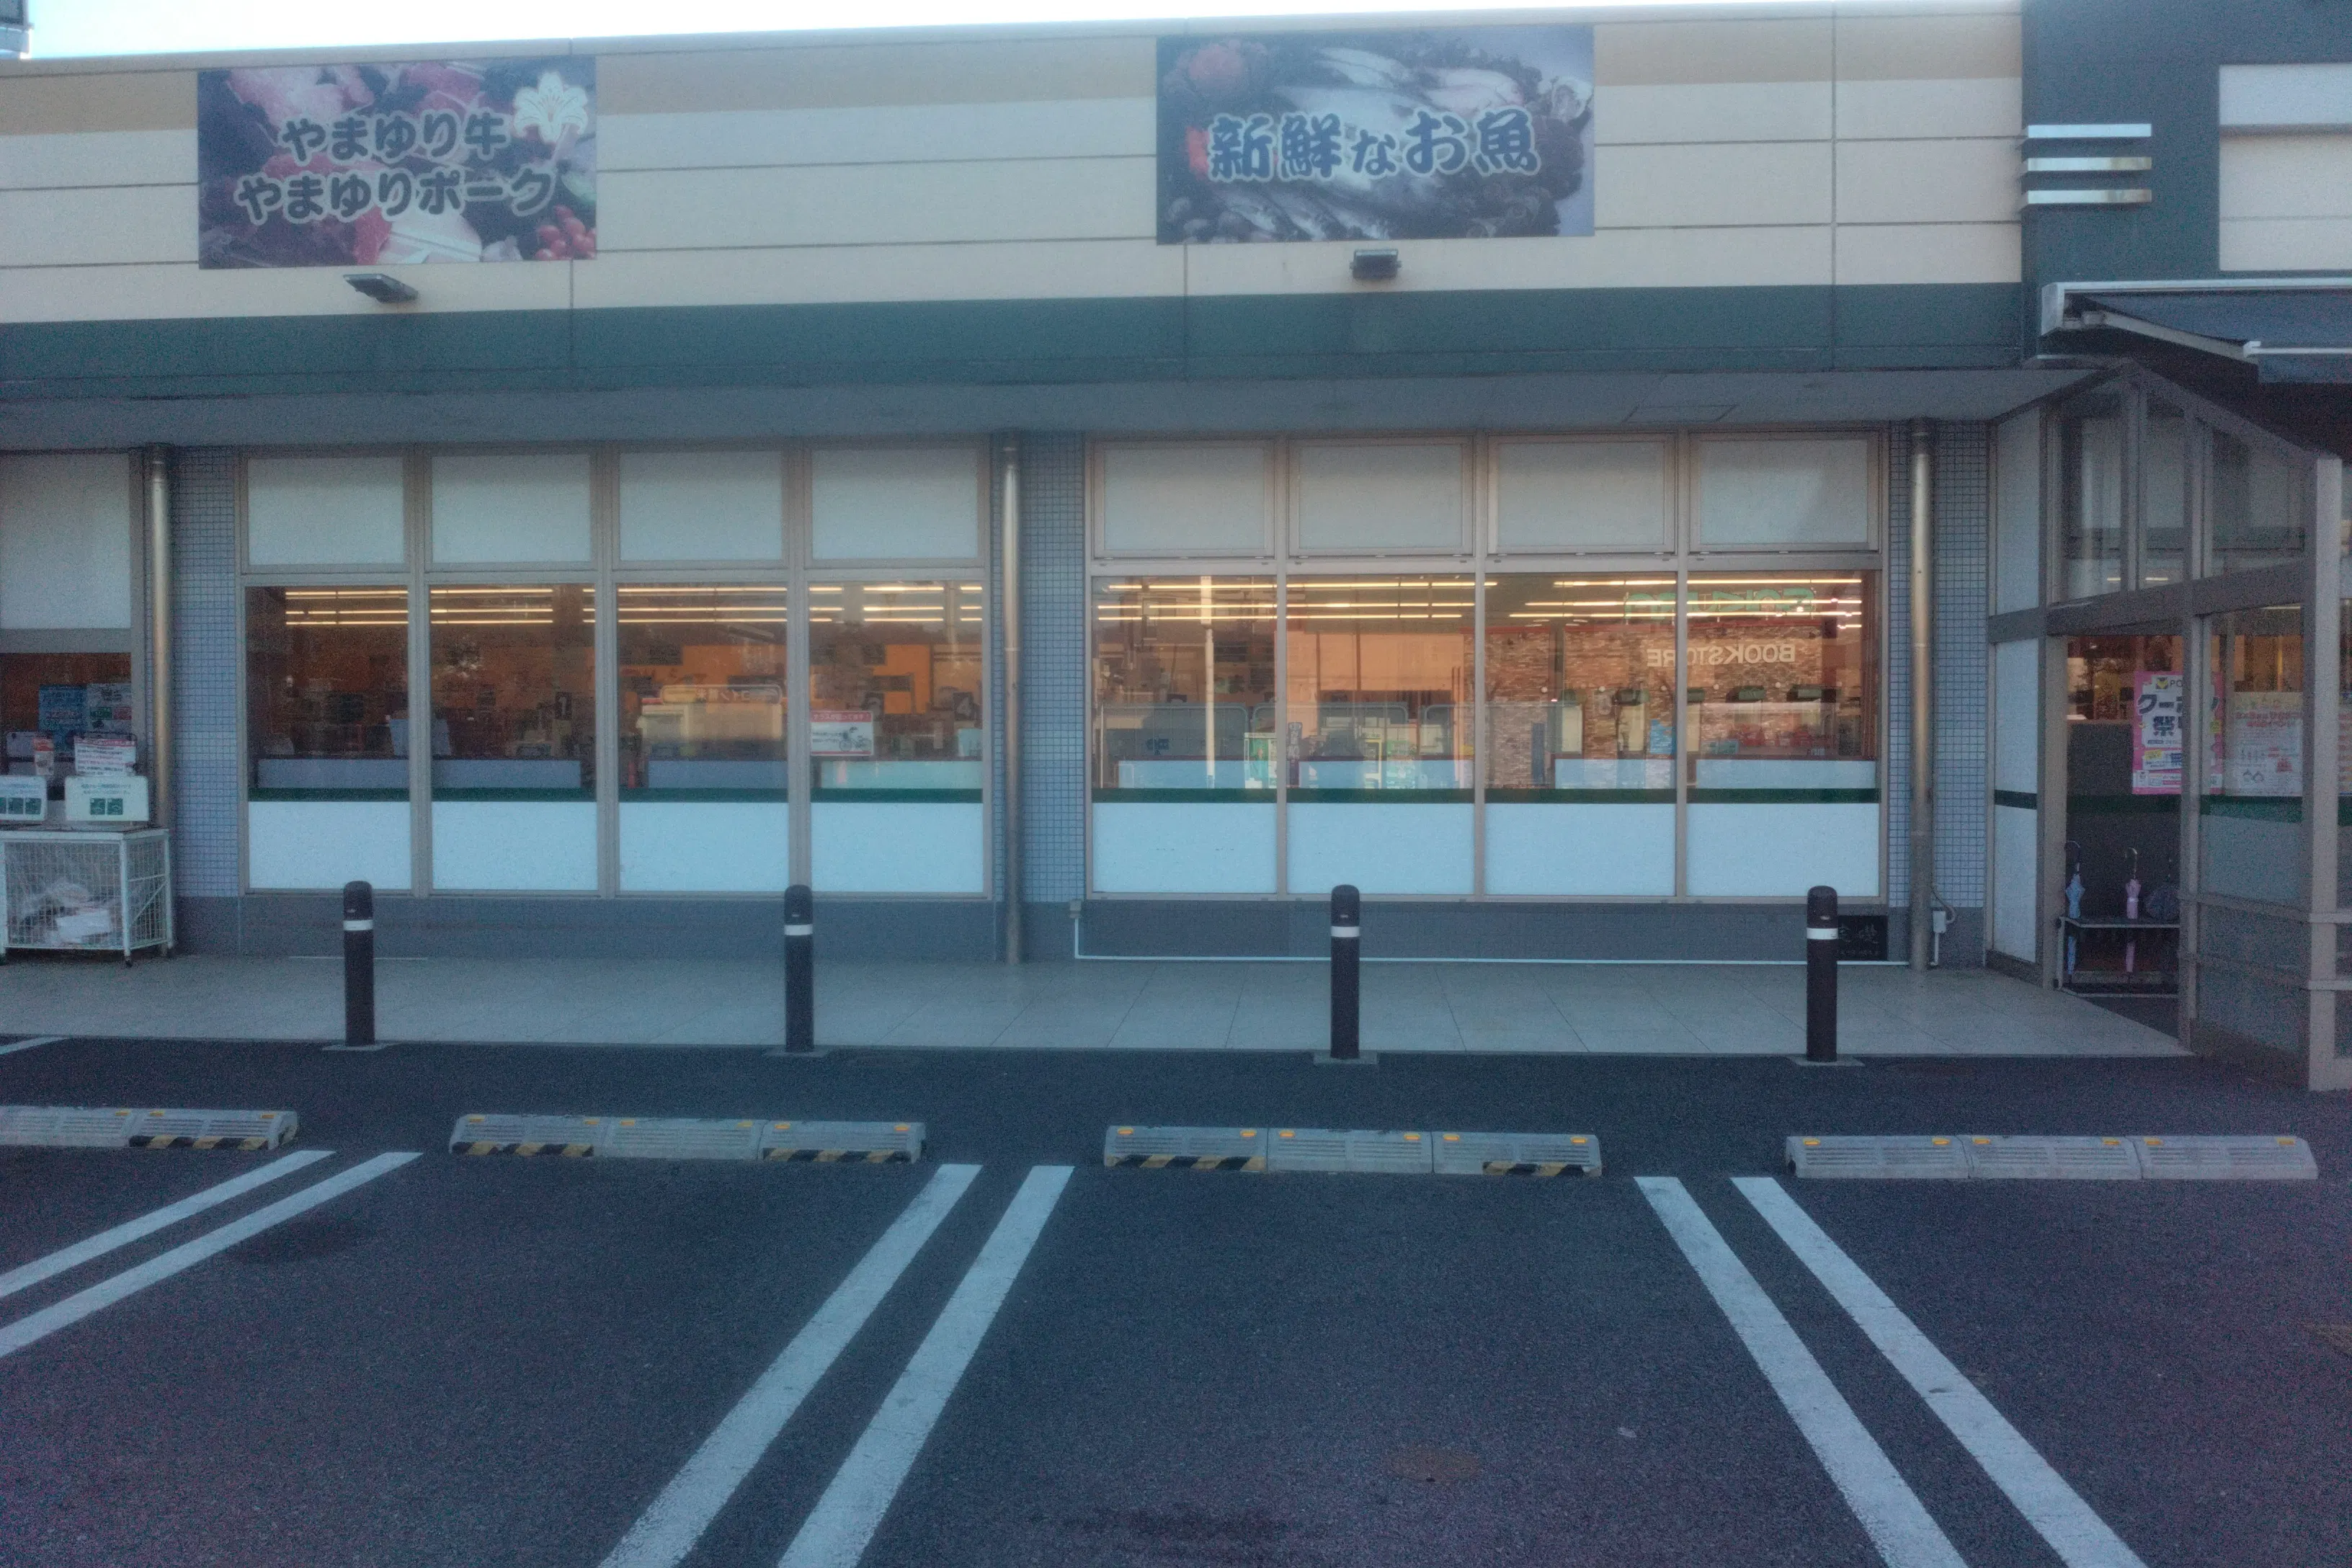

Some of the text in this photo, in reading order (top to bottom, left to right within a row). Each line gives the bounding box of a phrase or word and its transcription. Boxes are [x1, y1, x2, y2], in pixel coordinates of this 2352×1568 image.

[281, 110, 508, 163] やまゆり牛
[1208, 105, 1539, 181] 新鮮なお魚
[237, 166, 554, 223] やまゆりポーク
